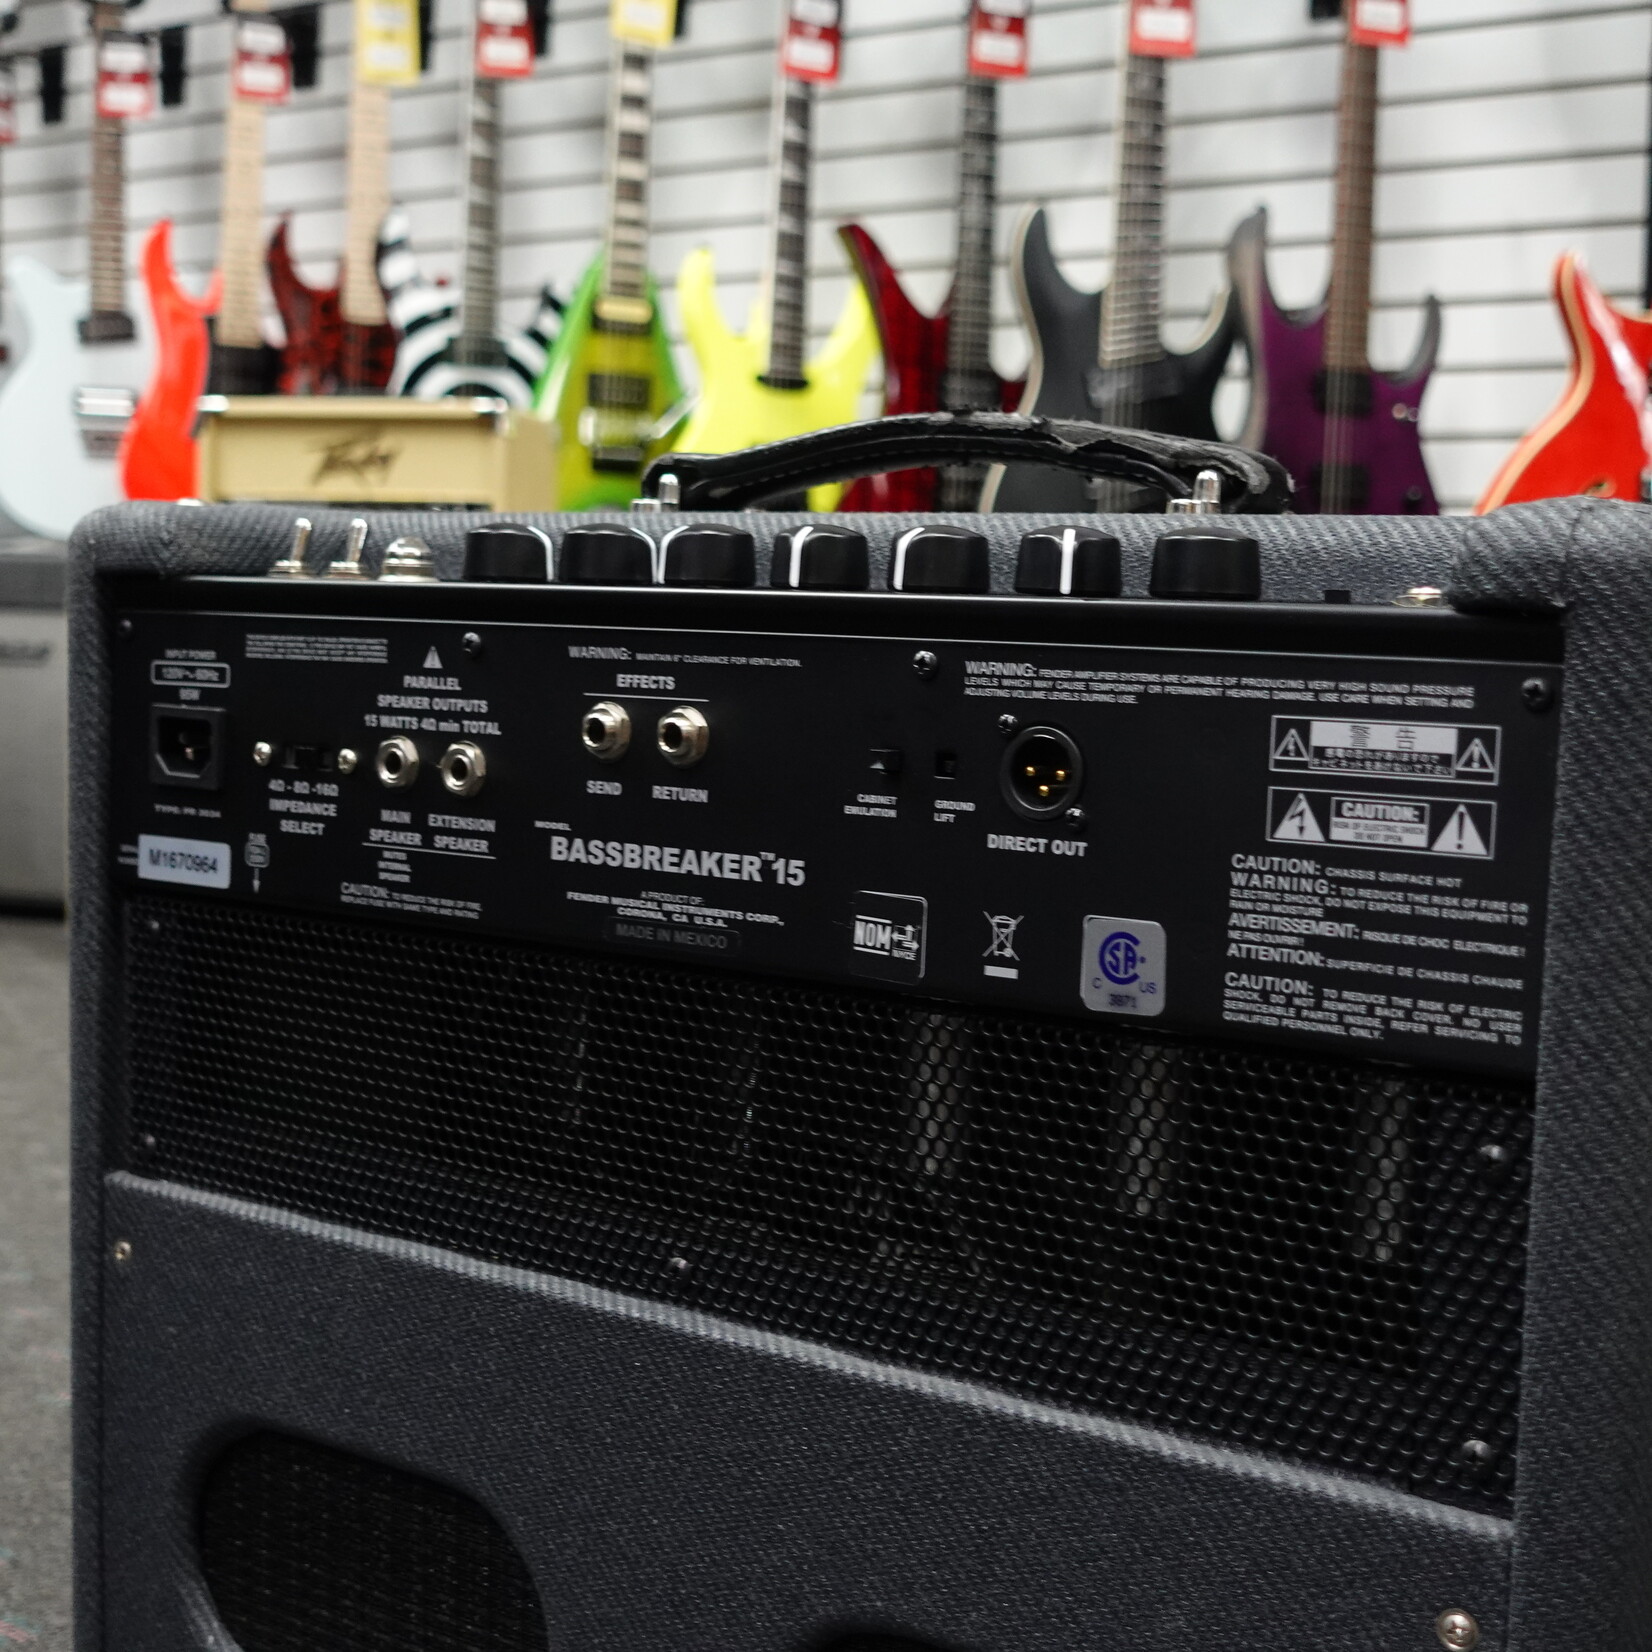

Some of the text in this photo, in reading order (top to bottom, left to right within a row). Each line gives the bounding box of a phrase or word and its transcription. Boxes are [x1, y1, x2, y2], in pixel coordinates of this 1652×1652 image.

[568, 646, 632, 660] WARNING:
[683, 655, 729, 664] CLEARANCE
[730, 656, 747, 665] FOR
[403, 675, 462, 690] PARALLEL
[616, 674, 675, 690] EFFECTS
[965, 661, 1474, 696] WARNING: FENDER AMPLIFIER SYSTEMS ARE CAPABLE OF PRODUCING VERY HIGH SOUND PRESSURE
[964, 676, 999, 687] LEVELS
[1001, 678, 1032, 688] WHICH
[1033, 679, 1053, 688] MAY
[1055, 680, 1086, 690] CAUSE
[1089, 681, 1145, 693] TEMPORARY
[1147, 684, 1162, 694] OR
[1164, 685, 1224, 697] PERMANENT
[1225, 688, 1270, 699] HEARING
[1318, 692, 1339, 703] USE
[1340, 694, 1369, 704] CARE
[1371, 695, 1402, 705] WHEN
[1404, 697, 1448, 707] SETTING
[1450, 698, 1474, 708] AND
[964, 688, 1138, 704] ADJUSTING VOLUME LEVELS DURING USE.
[377, 694, 488, 713] SPEAKER OUTPUTS
[364, 714, 378, 727] 15
[379, 715, 419, 730] WATTS
[438, 720, 460, 732] min
[462, 720, 502, 736] TOTAL
[586, 780, 622, 795] SEND
[652, 785, 708, 803] RETURN
[269, 798, 337, 816] IMPEDANCE
[857, 794, 898, 805] CABINET
[934, 800, 976, 812] GROUND
[381, 809, 411, 824] MAIN
[844, 805, 896, 818] EMULATION
[934, 813, 955, 823] LIFT
[1341, 802, 1420, 821] CAUTION:
[280, 819, 325, 836] SELECT
[428, 813, 496, 832] EXTENSION
[534, 820, 572, 831] MODEL
[369, 828, 422, 846] SPEAKER
[433, 835, 489, 853] SPEAKER
[987, 833, 1088, 857] DIRECT OUT
[772, 858, 806, 887] 15
[1231, 854, 1462, 888] CAUTION: CHASSIS SURFACE HOT
[640, 891, 647, 899] A
[647, 892, 688, 903] PRODUCT
[1230, 871, 1528, 913] WARNING: TO REDUCE THE RISK OF FIRE OR
[567, 891, 609, 904] FENDER
[612, 896, 660, 910] MUSICAL
[662, 901, 744, 920] INSTRUMENTS
[1229, 888, 1281, 902] ELECTRIC
[1325, 897, 1342, 907] DO
[1343, 898, 1366, 909] NOT
[1368, 902, 1412, 915] EXPOSE
[1414, 905, 1439, 918] THIS
[1441, 908, 1508, 924] EQUIPMENT
[1512, 915, 1528, 926] TO
[1229, 899, 1324, 918] RAIN OR MOISTURE
[617, 907, 728, 928] CORONA, CA U.S.A.
[616, 923, 728, 949] MADE IN MEXICO
[853, 920, 892, 950] NOM
[1228, 912, 1360, 939] AVERTISSEMENT:
[1401, 935, 1417, 946] DE
[1417, 936, 1450, 949] CHOC
[1099, 932, 1140, 985] CSA
[1227, 942, 1523, 990] ATTENTION: SUPERFICIE DE CHASSIS CHAUDE
[1092, 977, 1156, 994] C US
[1224, 971, 1523, 1021] CAUTION: TO REDUCE THE RISK OF ELECTRIC
[1223, 999, 1296, 1017] SERVICEABLE
[1301, 1008, 1339, 1022] PARTS
[1390, 1020, 1429, 1034] REFER
[1434, 1025, 1499, 1043] SERVICING
[1504, 1034, 1522, 1046] TO
[1269, 993, 1286, 1004] DO
[1292, 996, 1316, 1008] NOT
[1322, 1000, 1368, 1014] REMOVE
[1374, 1006, 1406, 1018] BACK
[1462, 1017, 1481, 1028] NO
[1489, 1020, 1522, 1033] USER
[1222, 1010, 1384, 1040] QUALIFIED PERSONNEL ONLY.
